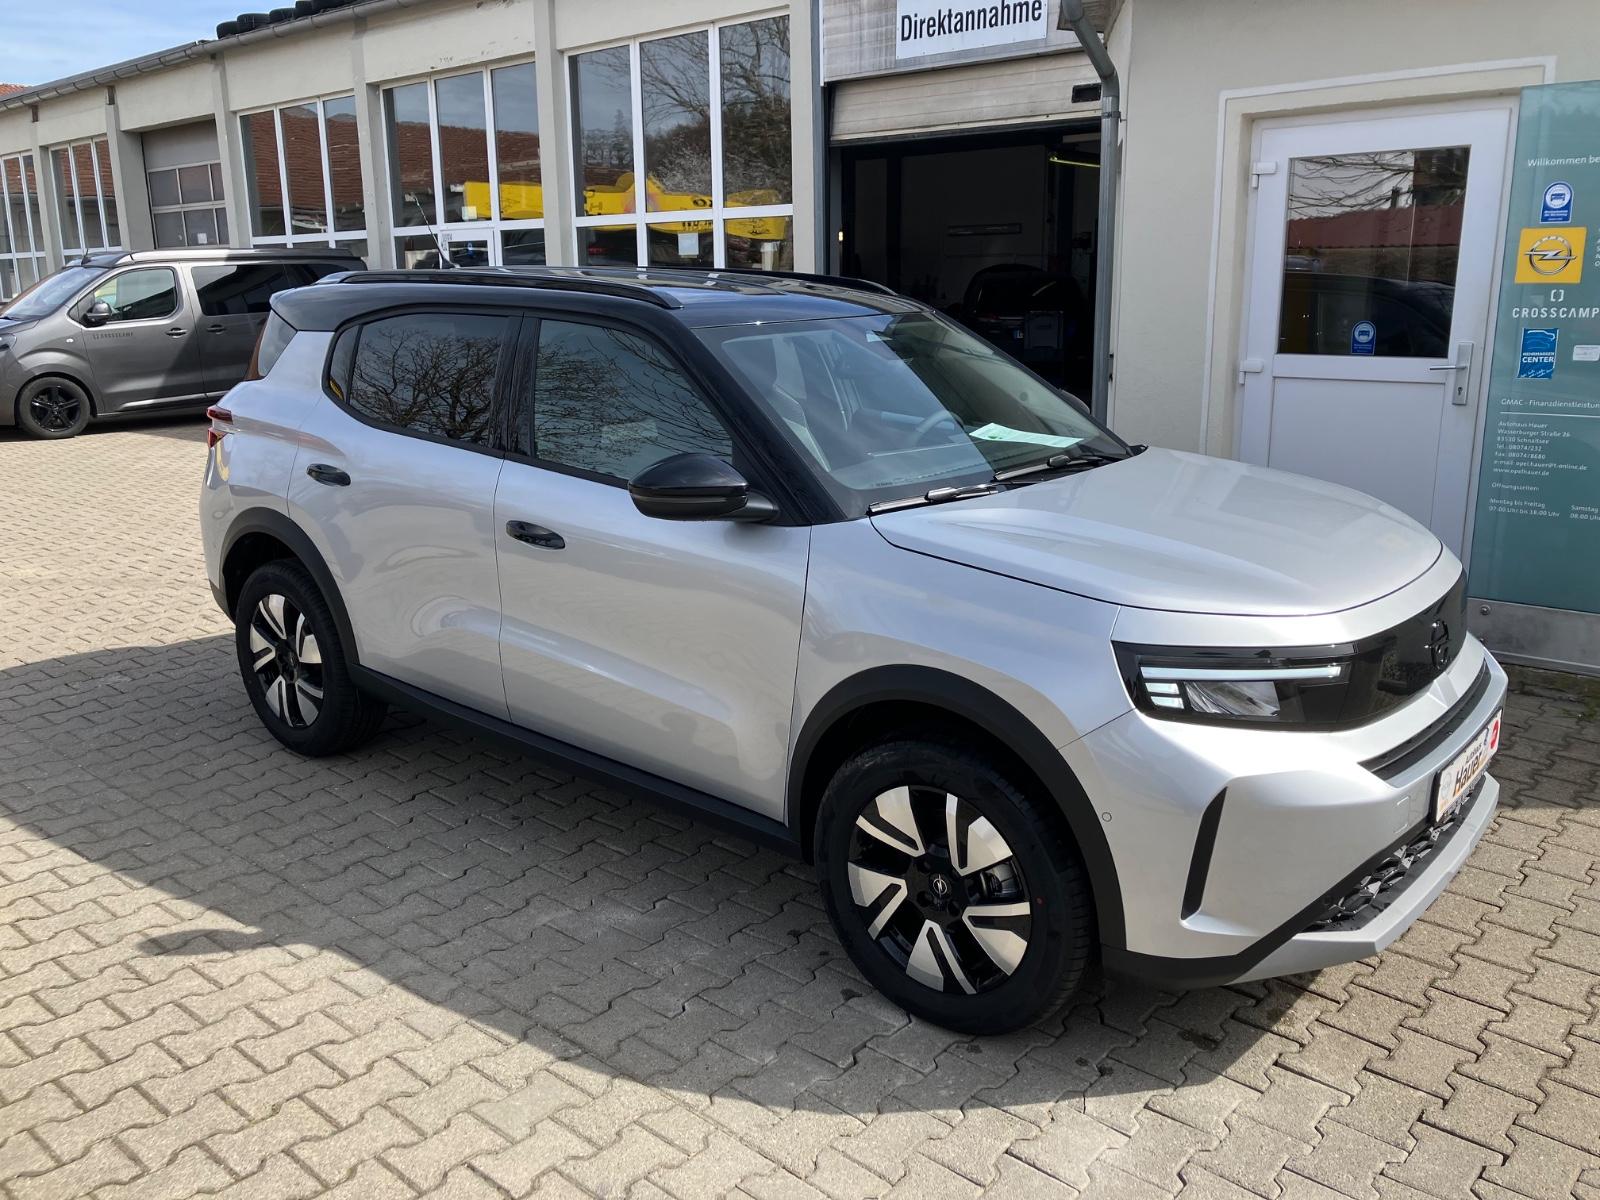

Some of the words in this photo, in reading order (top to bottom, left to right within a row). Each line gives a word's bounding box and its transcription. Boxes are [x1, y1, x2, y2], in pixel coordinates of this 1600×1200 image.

[901, 0, 1042, 41] Direktannahme
[1528, 156, 1587, 167] Willkommen
[1512, 307, 1600, 318] CROSSCAMP
[1501, 398, 1524, 406] GMAC
[1498, 420, 1528, 428] Autohaus
[1497, 428, 1539, 437] Wasserburger
[1489, 498, 1513, 506] Montag
[1524, 500, 1546, 509] Freitag
[1571, 504, 1599, 514] Samstag
[1453, 750, 1483, 797] Hauer
